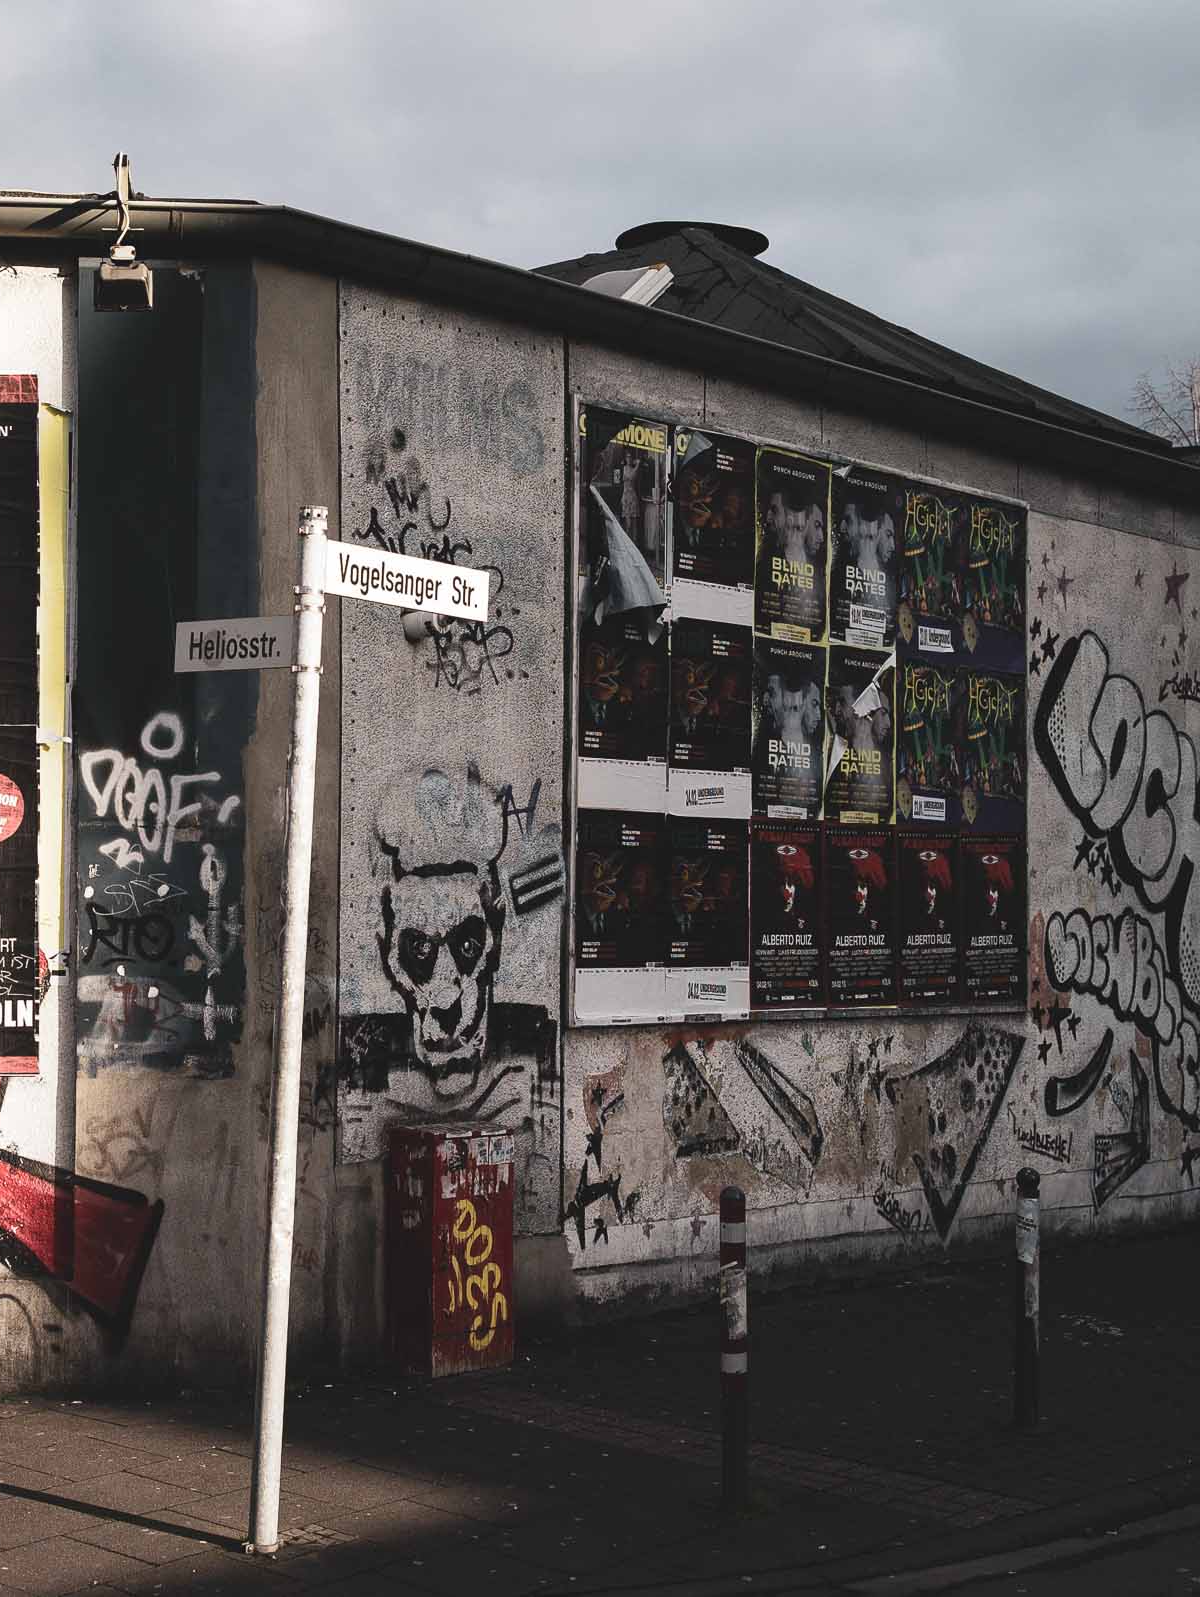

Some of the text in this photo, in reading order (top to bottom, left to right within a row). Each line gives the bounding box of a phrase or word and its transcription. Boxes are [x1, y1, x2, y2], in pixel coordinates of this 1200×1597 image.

[772, 557, 815, 576] BLIND
[845, 565, 886, 584] BLIND
[339, 552, 478, 609] Vogelsanger Str.
[772, 571, 814, 590] DATES
[845, 579, 886, 597] DATES
[189, 631, 281, 661] Heliosstr.
[768, 739, 811, 757] BLIND
[841, 748, 881, 763] BLIND
[768, 754, 811, 770] DATES
[840, 761, 881, 776] DATES
[761, 934, 813, 946] ALBERTO RUIZ
[835, 934, 885, 947] ALBERTO RUIZ
[906, 933, 952, 946] ALBERTO RUIZ
[970, 935, 1013, 947] ALBERTO RUIZ
